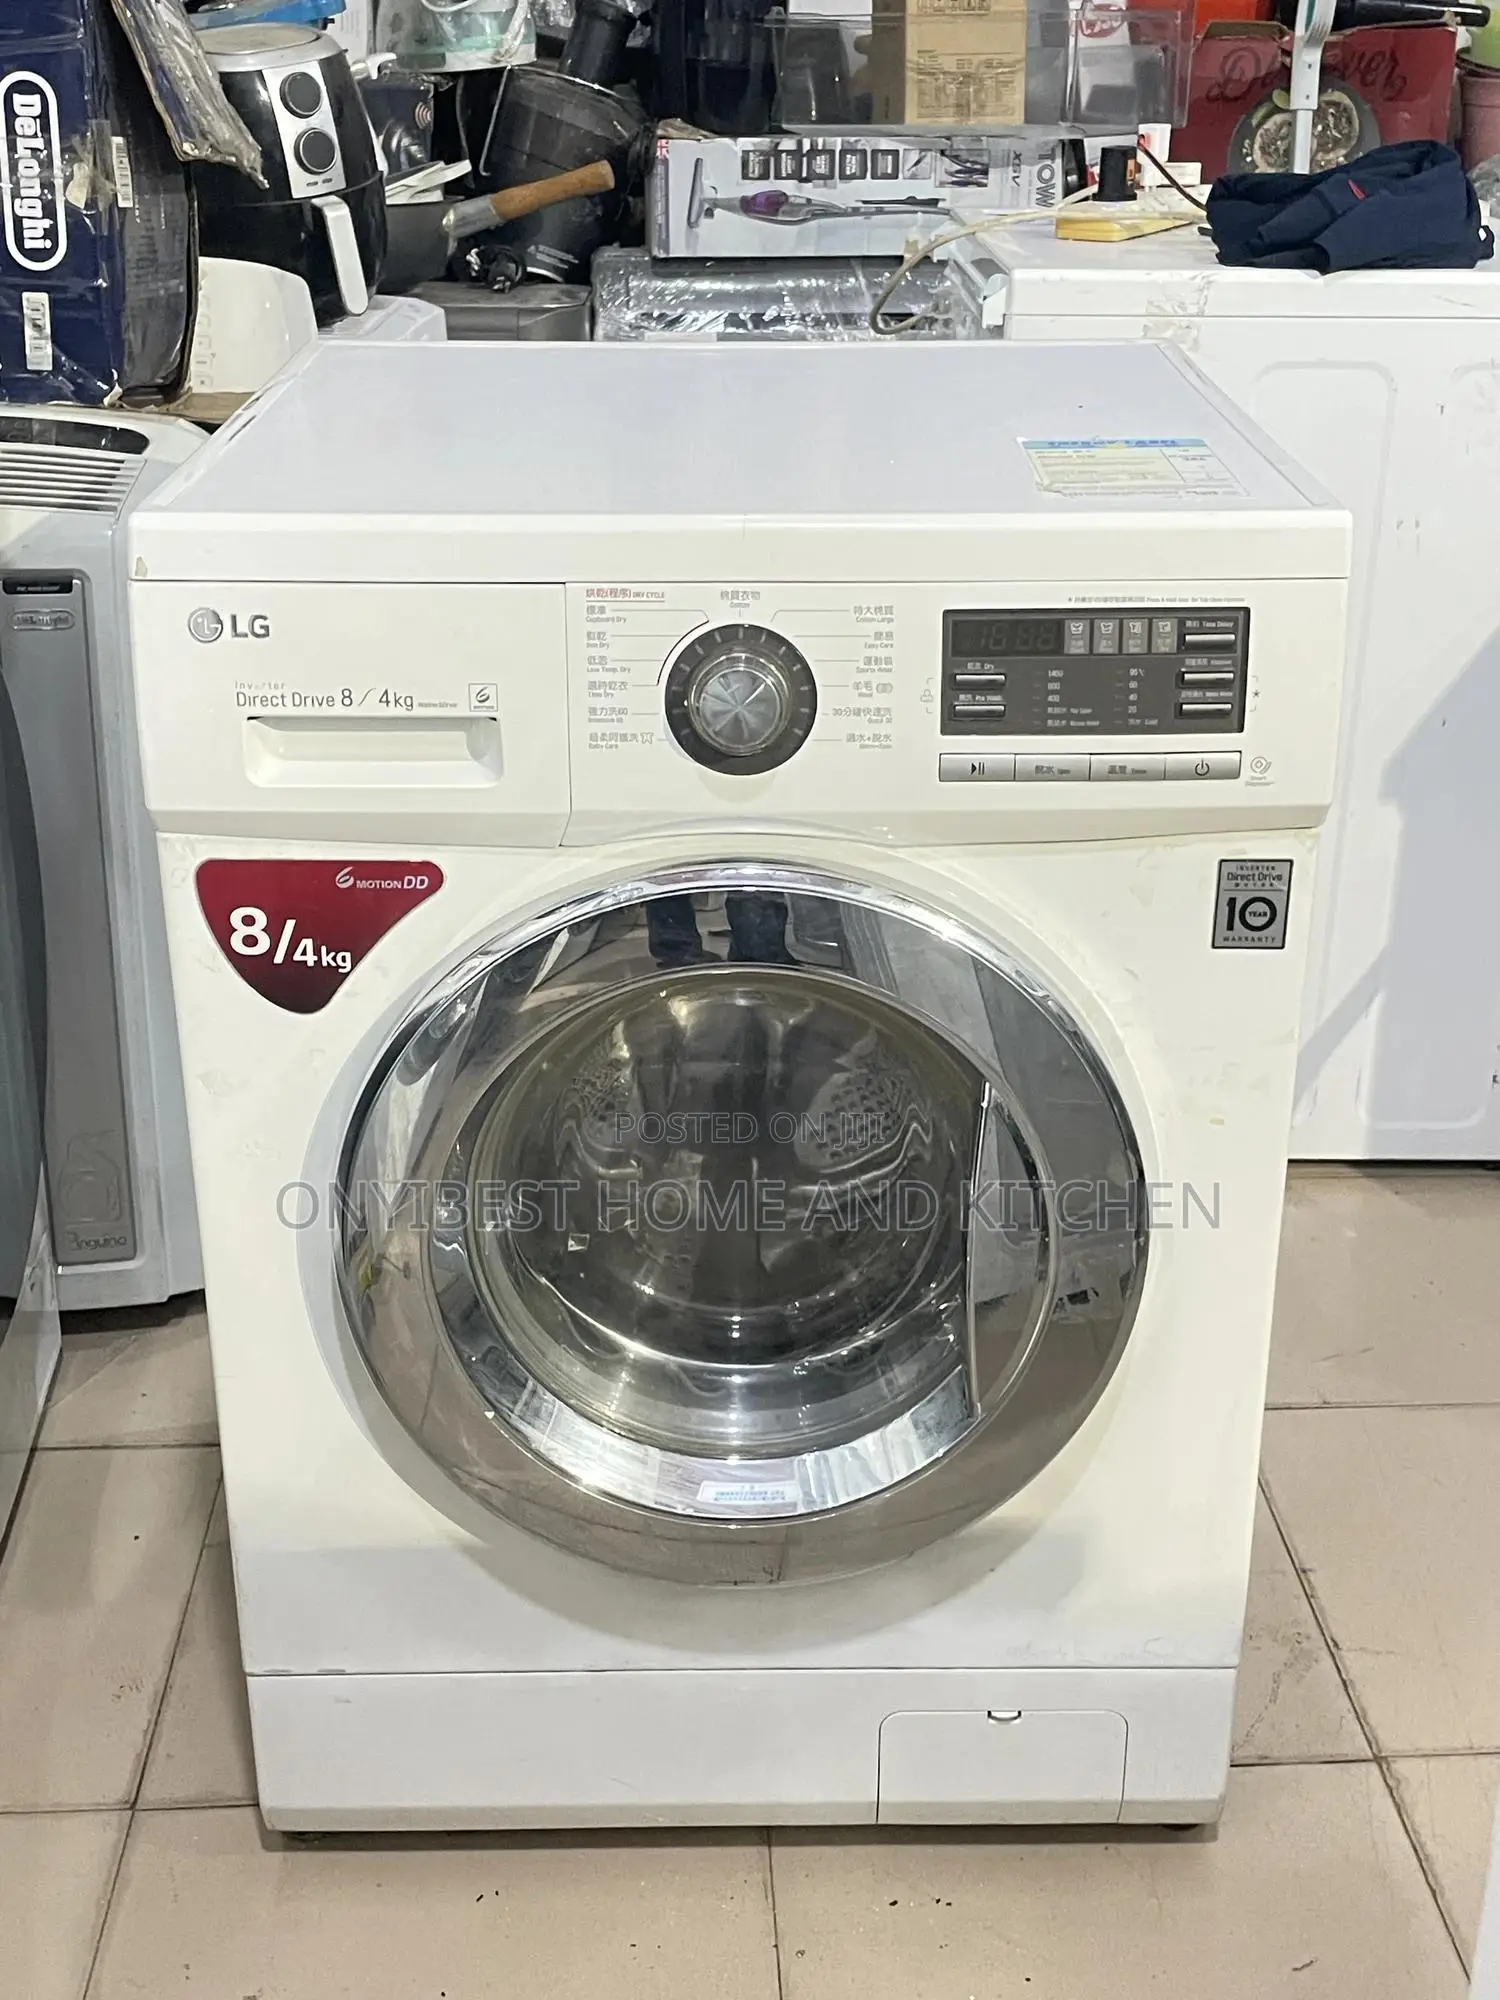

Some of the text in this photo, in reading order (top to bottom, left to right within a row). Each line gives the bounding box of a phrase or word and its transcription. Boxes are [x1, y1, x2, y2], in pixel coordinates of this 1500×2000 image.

[230, 614, 270, 639] LG
[234, 681, 286, 690] Invrter
[236, 692, 287, 707] Direct
[292, 692, 335, 708] Drive
[341, 688, 353, 707] 8
[356, 880, 402, 889] MOTION
[403, 876, 429, 889] DD
[1226, 872, 1283, 881] Direct Drive
[1226, 896, 1277, 932] 10
